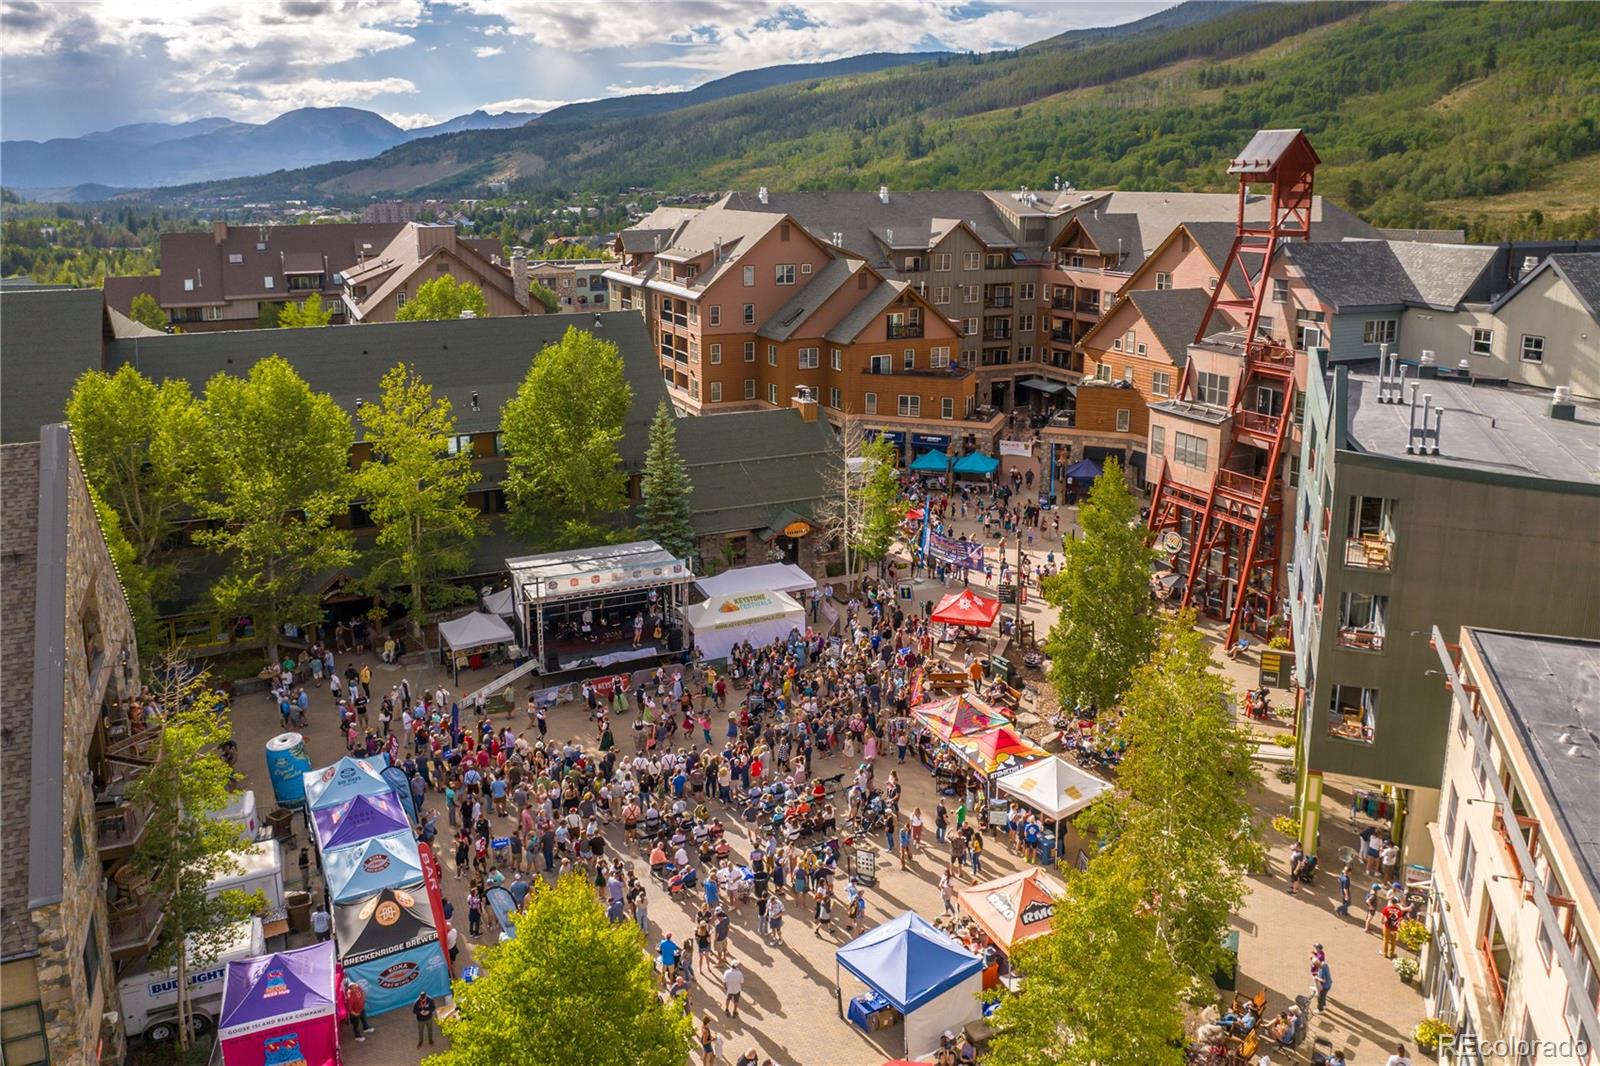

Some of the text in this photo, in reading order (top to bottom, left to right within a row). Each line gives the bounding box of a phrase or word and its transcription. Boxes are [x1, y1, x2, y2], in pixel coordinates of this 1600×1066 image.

[421, 853, 438, 890] BAR
[343, 942, 405, 966] BRECKENRIDGE
[388, 963, 408, 972] KONA
[227, 1008, 326, 1035] GOOSE ISLAND BEER COMPANY
